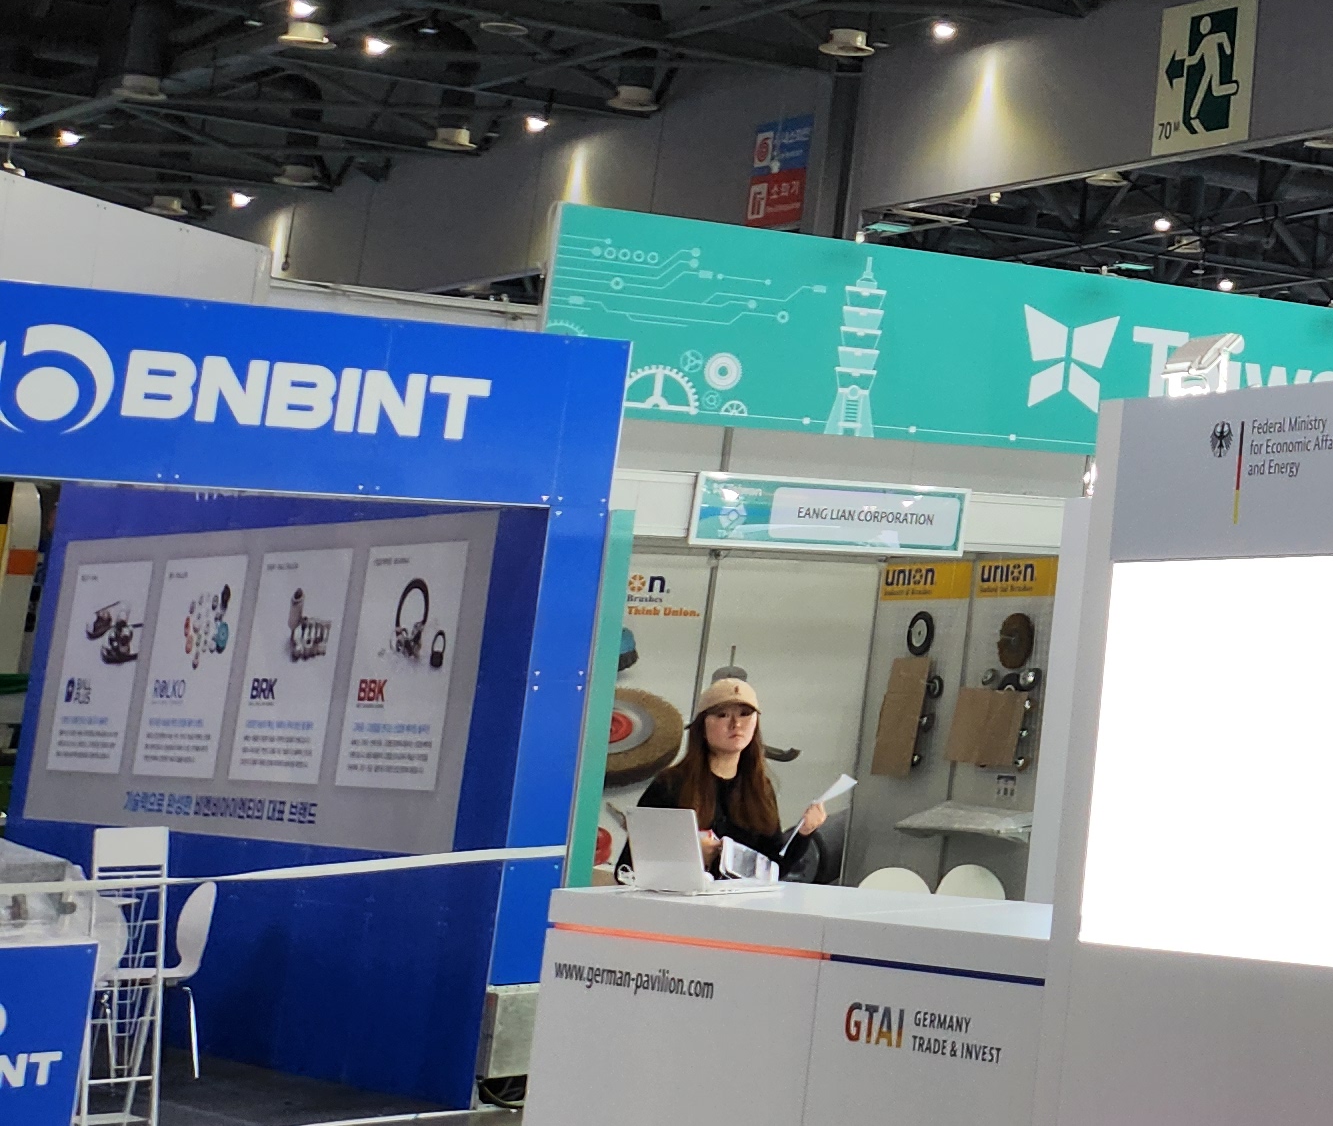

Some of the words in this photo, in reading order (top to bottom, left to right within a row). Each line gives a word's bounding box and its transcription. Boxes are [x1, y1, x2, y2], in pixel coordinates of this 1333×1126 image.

[120, 349, 492, 440] BNBINT
[1252, 419, 1286, 435] Federal
[1288, 415, 1328, 433] Ministry
[1250, 439, 1264, 455] for
[1265, 436, 1312, 455] Economic
[1247, 460, 1266, 476] and
[1268, 458, 1301, 478] Energy
[797, 506, 828, 521] EANG
[830, 508, 855, 522] LIAN
[857, 509, 934, 526] CORPORATION
[627, 605, 660, 616] Think
[250, 678, 278, 700] BRK
[357, 678, 388, 703] BBK
[554, 961, 715, 1000] www.german-pavilion.com
[844, 1001, 905, 1049] GTAI
[913, 1010, 972, 1034] GERMANY
[911, 1035, 947, 1056] TRADE
[949, 1040, 958, 1058] &
[960, 1042, 1002, 1064] INVEST
